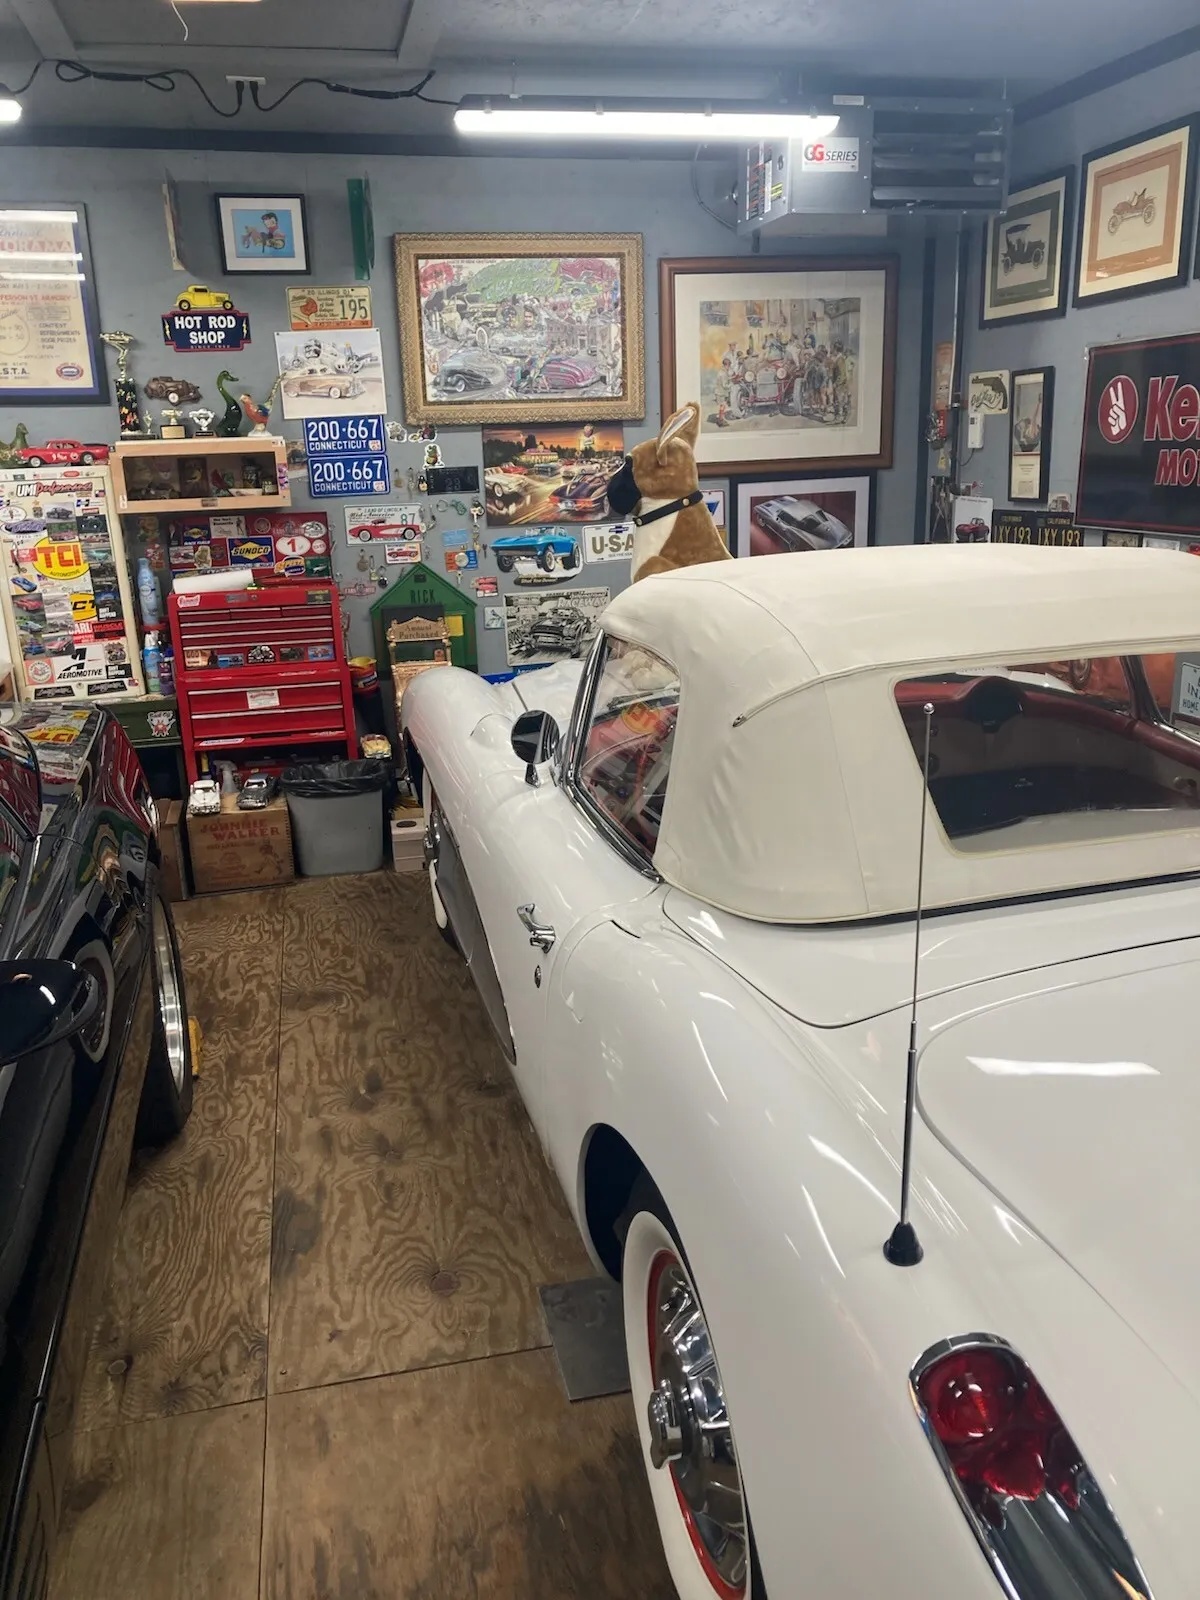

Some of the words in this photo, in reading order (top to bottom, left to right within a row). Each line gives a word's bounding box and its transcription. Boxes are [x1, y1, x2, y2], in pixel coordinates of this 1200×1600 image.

[825, 150, 858, 162] SERIES
[339, 298, 369, 320] 195
[174, 315, 203, 329] HOT
[208, 315, 237, 329] ROD
[189, 331, 226, 344] SHOP
[309, 440, 367, 452] CONNECTICUT
[17, 483, 37, 498] UMI
[314, 481, 372, 492] CONNECTICUT
[232, 547, 270, 555] SUNOCO
[286, 538, 297, 552] 1
[37, 544, 82, 568] TCI
[409, 589, 437, 604] RICK
[557, 597, 606, 608] RACEWAY
[405, 624, 432, 632] Amount
[399, 631, 439, 640] Purchased
[57, 669, 103, 680] AEROMOTIVE
[1182, 698, 1199, 711] HOME
[213, 827, 281, 841] WALKER
